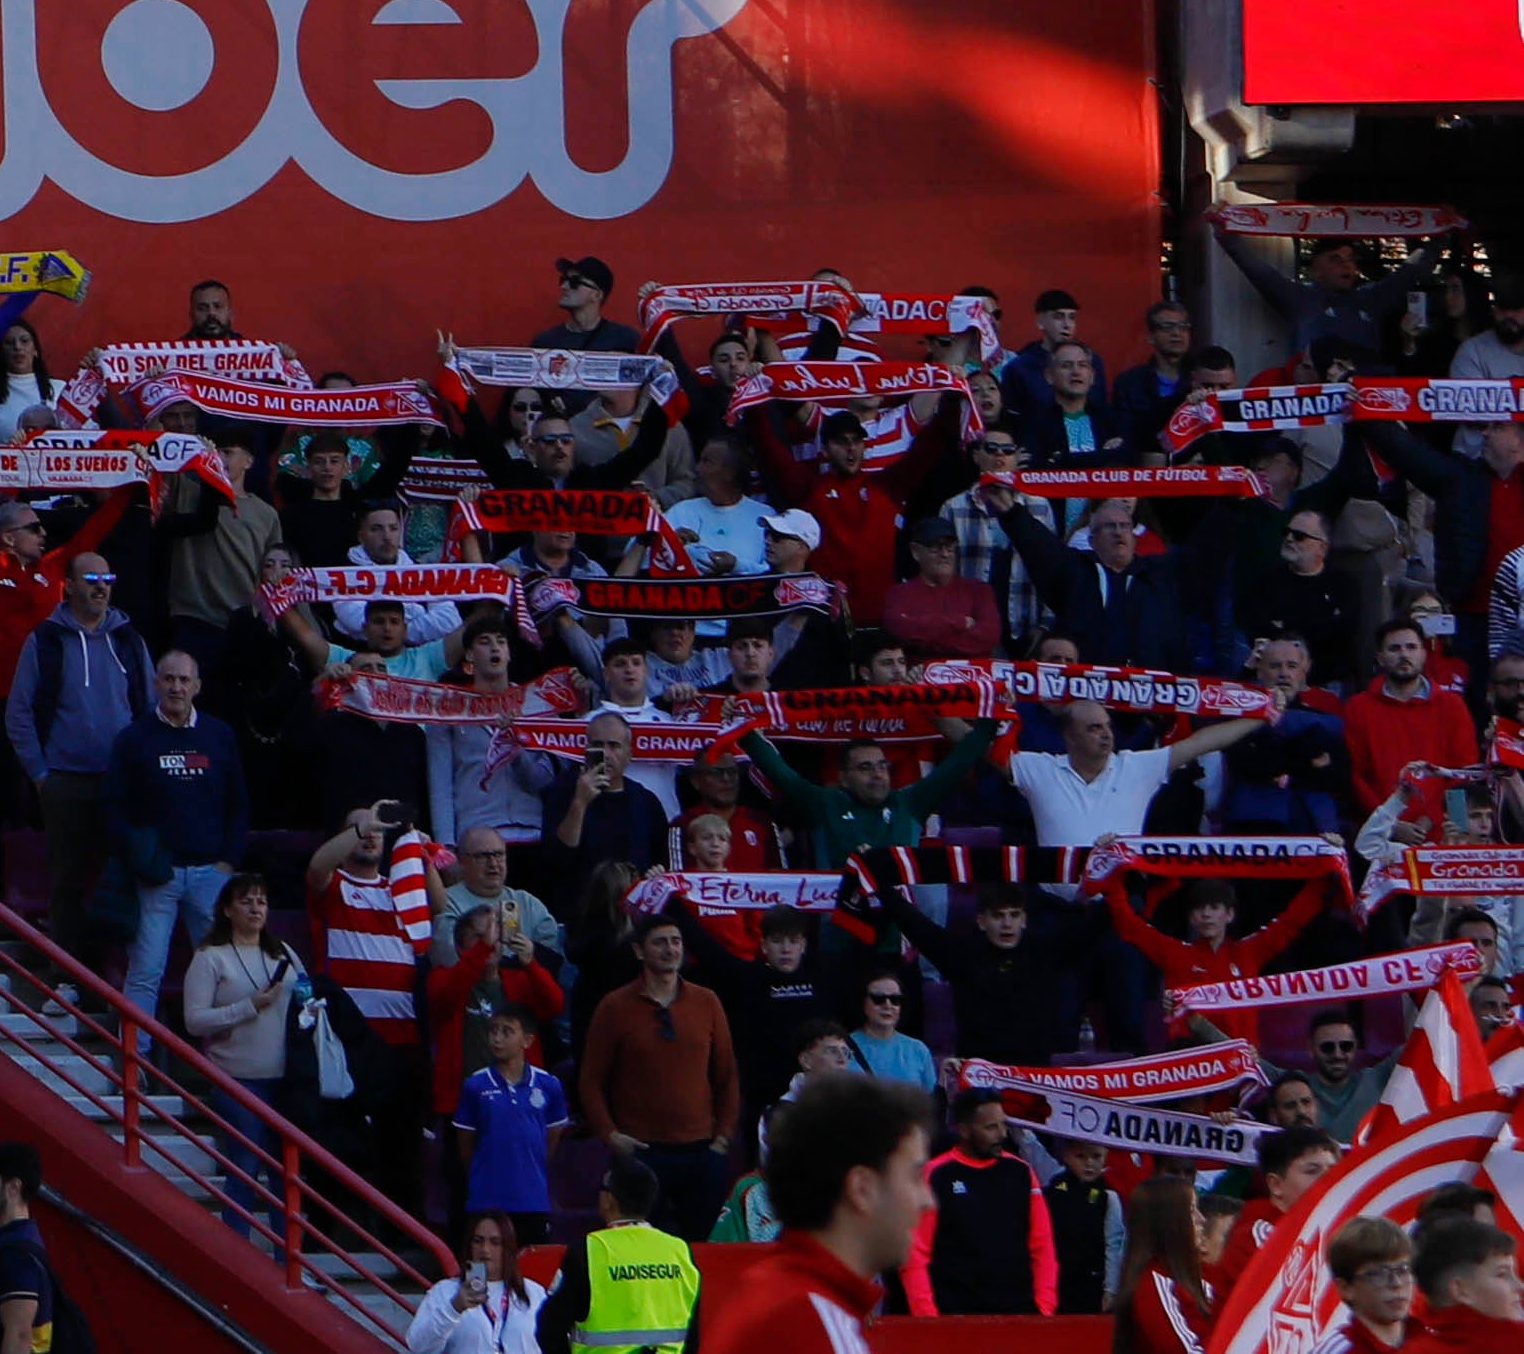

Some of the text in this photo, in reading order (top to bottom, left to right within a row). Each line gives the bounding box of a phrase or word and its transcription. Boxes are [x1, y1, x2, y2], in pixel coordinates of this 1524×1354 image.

[195, 383, 380, 413] VAMOS MI GRANADA
[1239, 393, 1344, 421] GRANADA
[1, 455, 20, 472] DE
[46, 452, 129, 472] LOS SUEÑOS
[1021, 466, 1209, 485] GRANADA CLUB DE FÚTBOL
[699, 876, 790, 908] Eterna
[1029, 1059, 1226, 1090] VAMOS MI GRANADA
